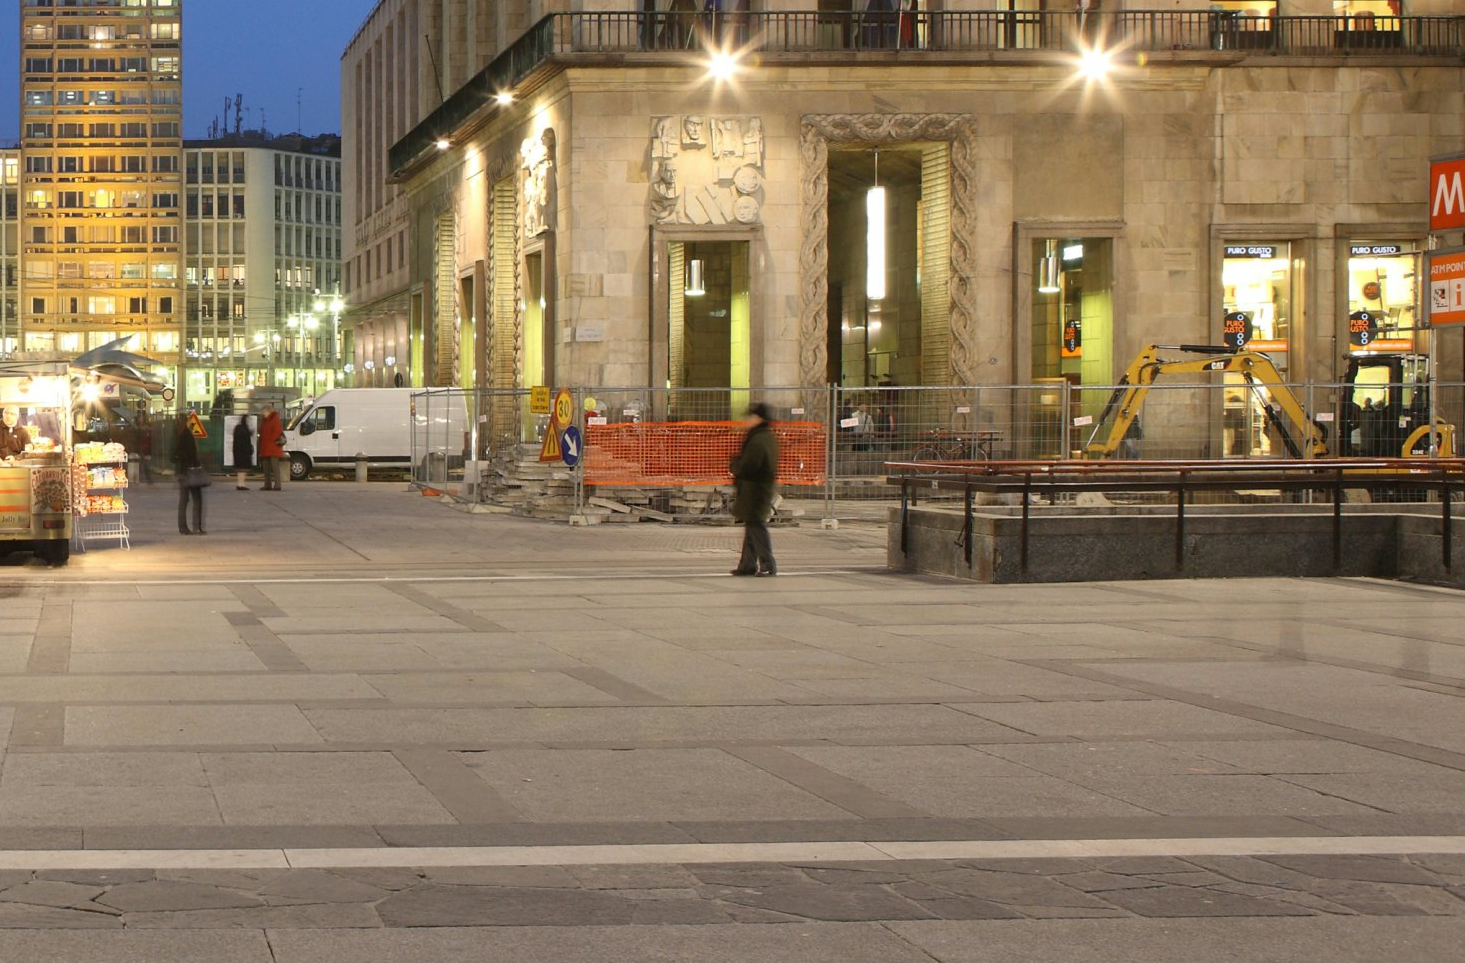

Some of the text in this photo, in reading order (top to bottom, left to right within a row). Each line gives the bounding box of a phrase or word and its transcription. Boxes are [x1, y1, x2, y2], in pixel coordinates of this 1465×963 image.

[1432, 171, 1465, 217] M
[1227, 247, 1272, 255] PURO GUSTO
[1351, 246, 1396, 254] PURO GUSTO
[1430, 264, 1445, 275] ATM
[558, 400, 570, 417] 30
